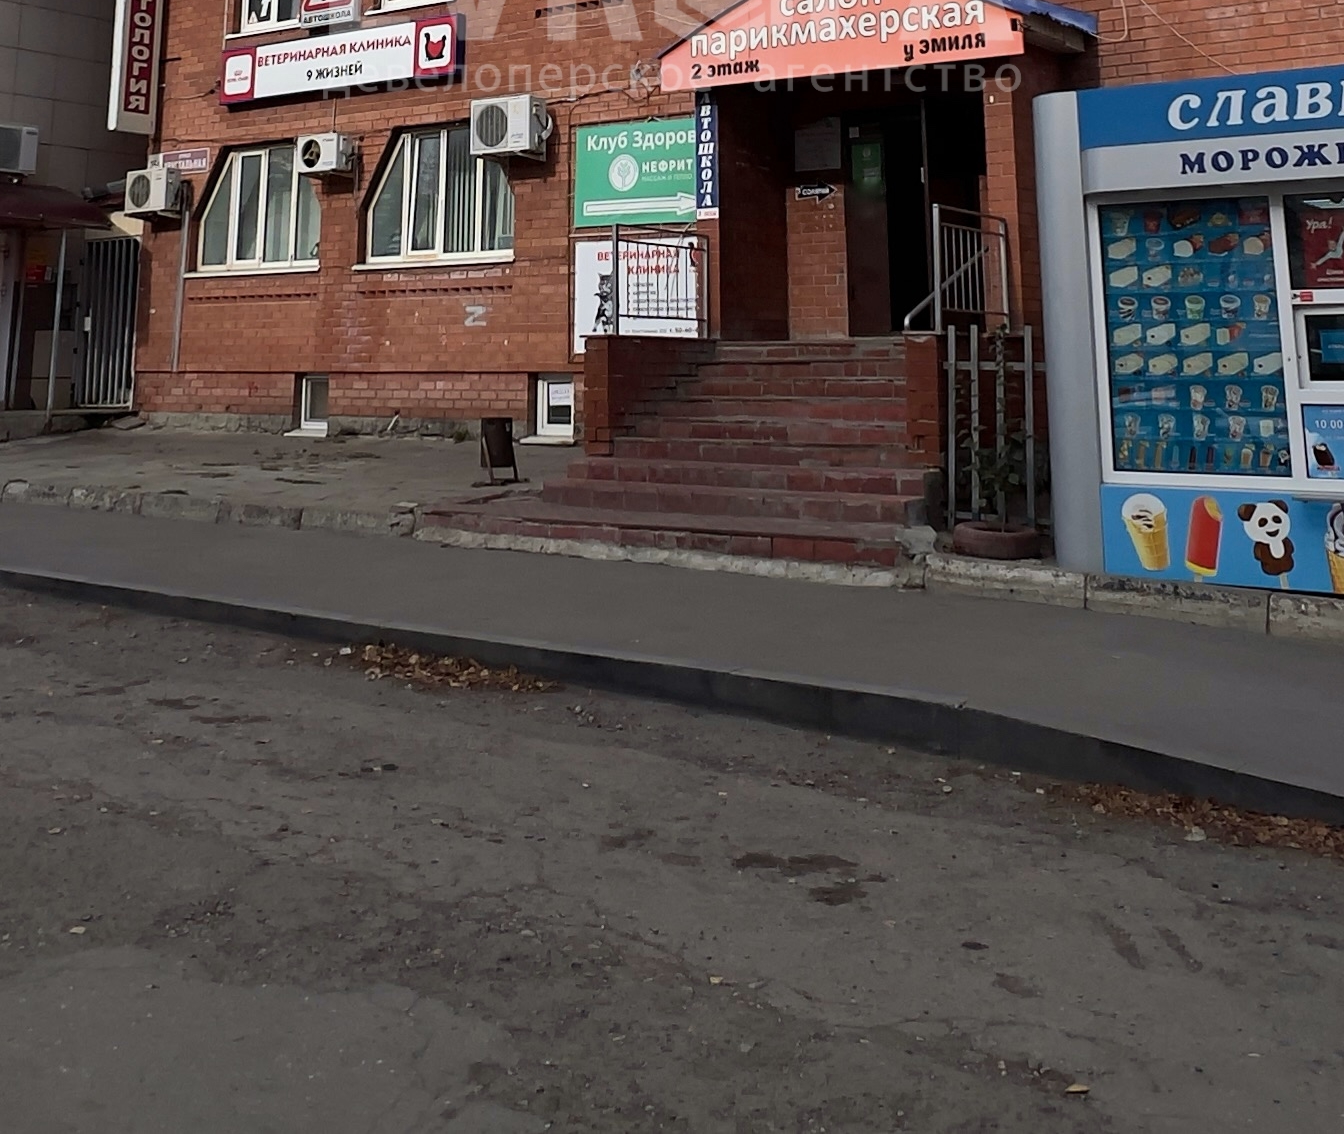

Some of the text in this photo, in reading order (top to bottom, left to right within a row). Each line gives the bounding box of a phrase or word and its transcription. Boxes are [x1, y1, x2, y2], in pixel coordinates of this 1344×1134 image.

[303, 9, 352, 25] АВТОШКОЛА
[690, 0, 985, 60] парикмахерская
[257, 34, 412, 68] ВЕТЕРИНАРНАЯ КЛИНИКА
[306, 60, 363, 82] 9 ЖИЗНЕЙ
[691, 57, 760, 80] 2 этаж
[587, 131, 628, 154] Клуб
[697, 92, 715, 207] АВТОШКОЛА
[641, 158, 694, 173] НЕФРИТ
